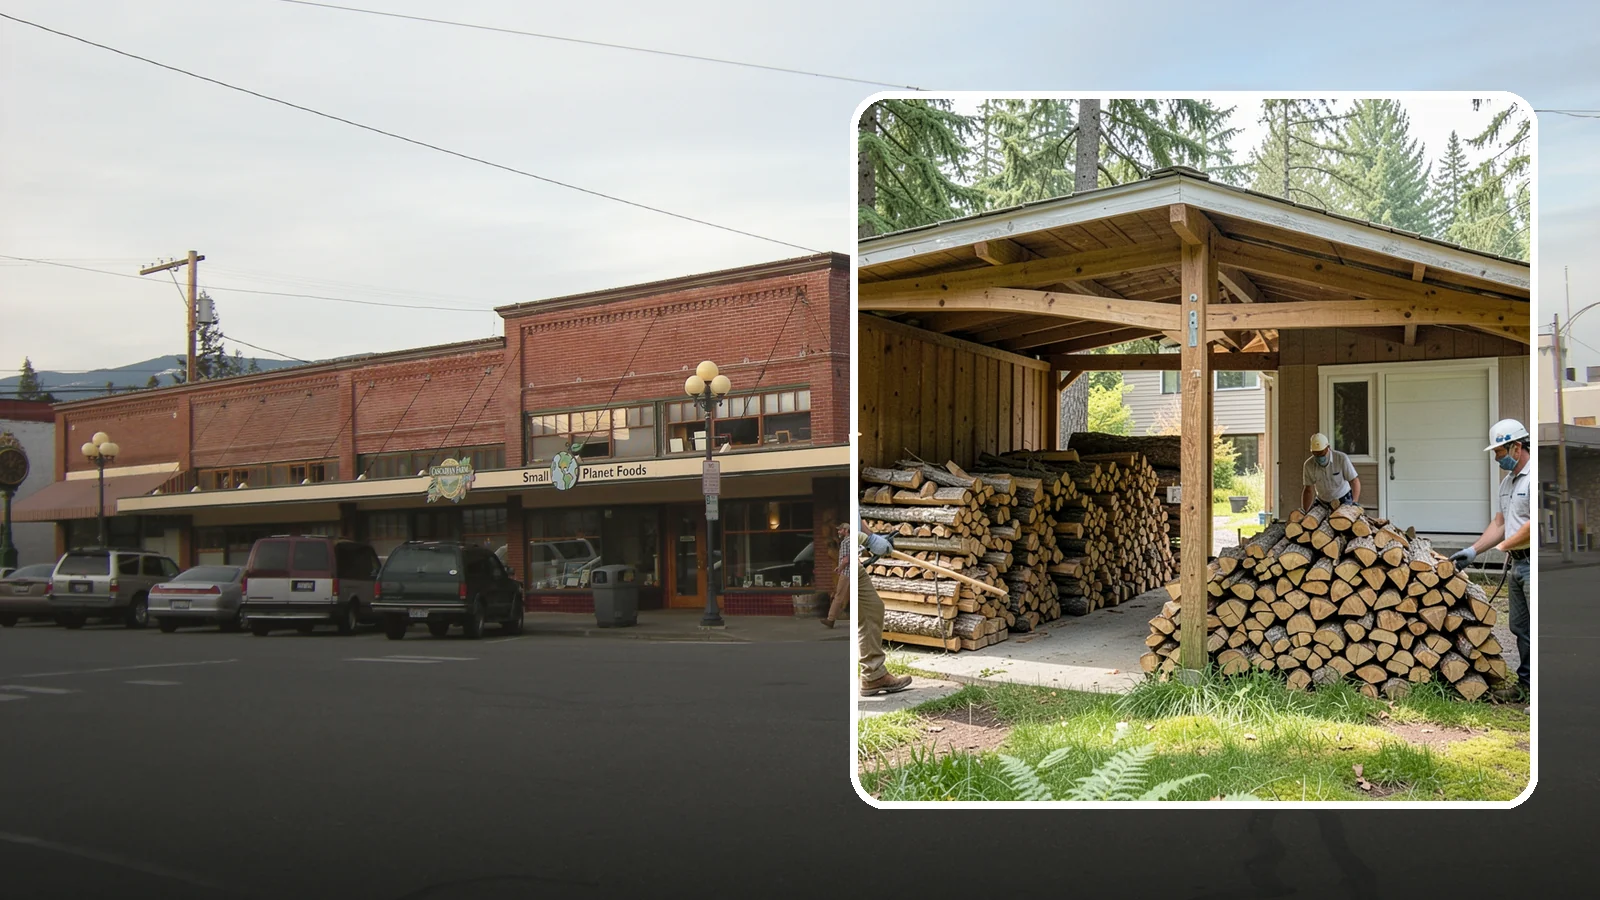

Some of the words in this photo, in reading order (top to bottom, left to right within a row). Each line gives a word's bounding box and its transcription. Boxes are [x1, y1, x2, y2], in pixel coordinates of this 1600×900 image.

[523, 471, 549, 483] Small
[583, 466, 614, 479] Planet
[616, 464, 647, 477] Foods
